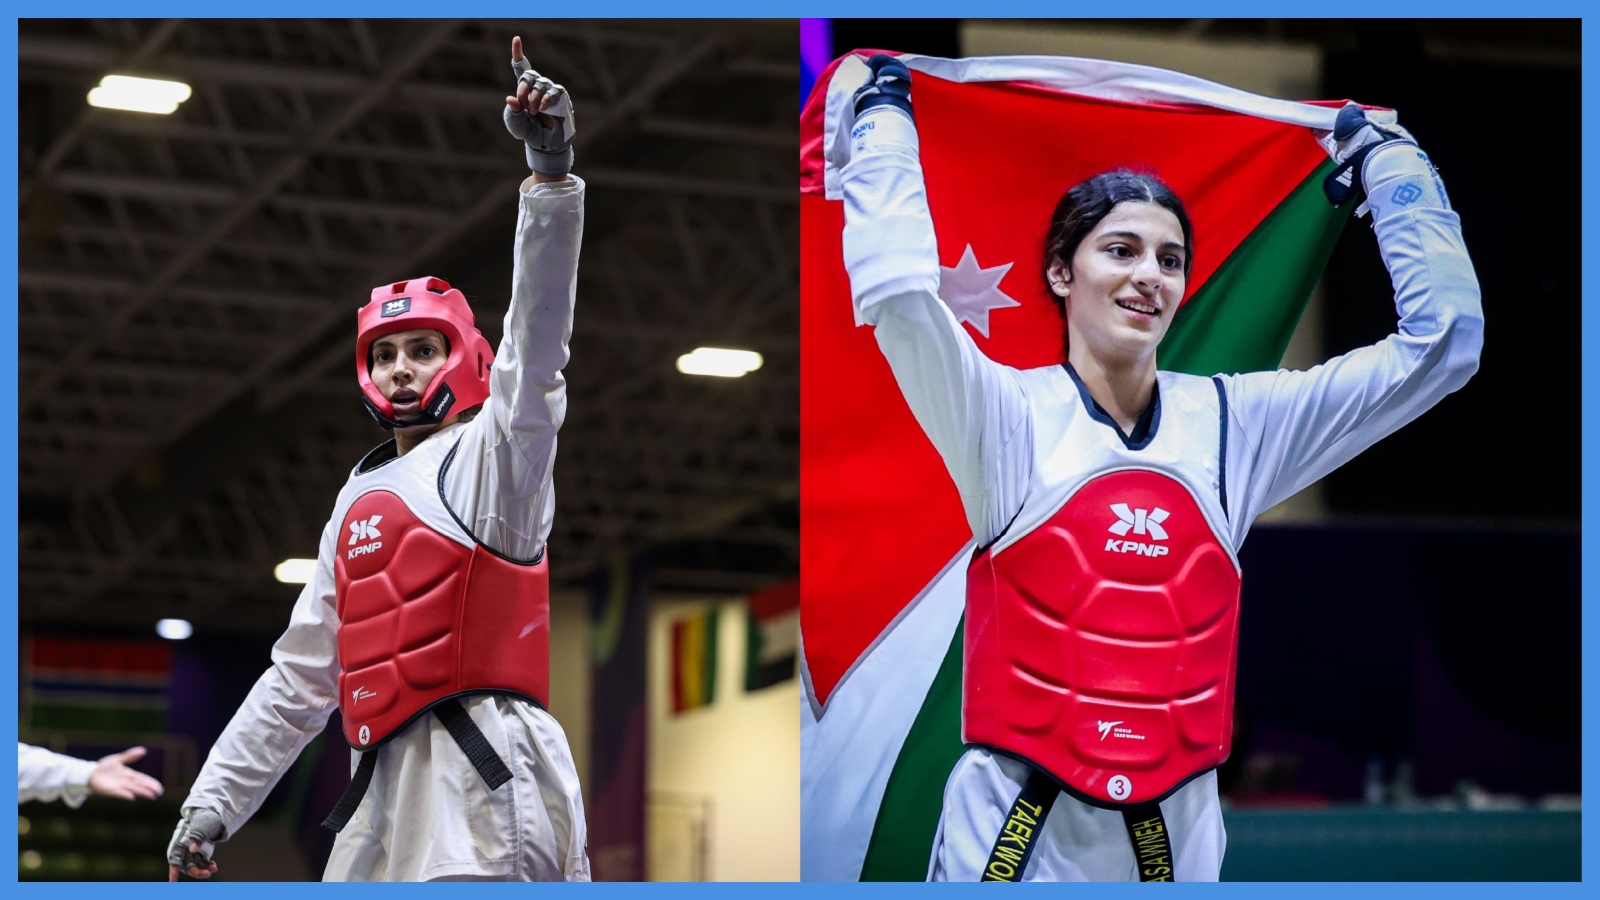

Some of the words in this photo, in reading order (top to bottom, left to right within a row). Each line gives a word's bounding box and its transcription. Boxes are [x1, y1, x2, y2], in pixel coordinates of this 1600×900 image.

[434, 392, 450, 417] KPNP
[348, 541, 382, 560] KPNP
[1104, 538, 1169, 558] KPNP
[361, 728, 368, 741] 4
[1113, 732, 1146, 740] TAEKWONDO
[1114, 779, 1125, 796] 3
